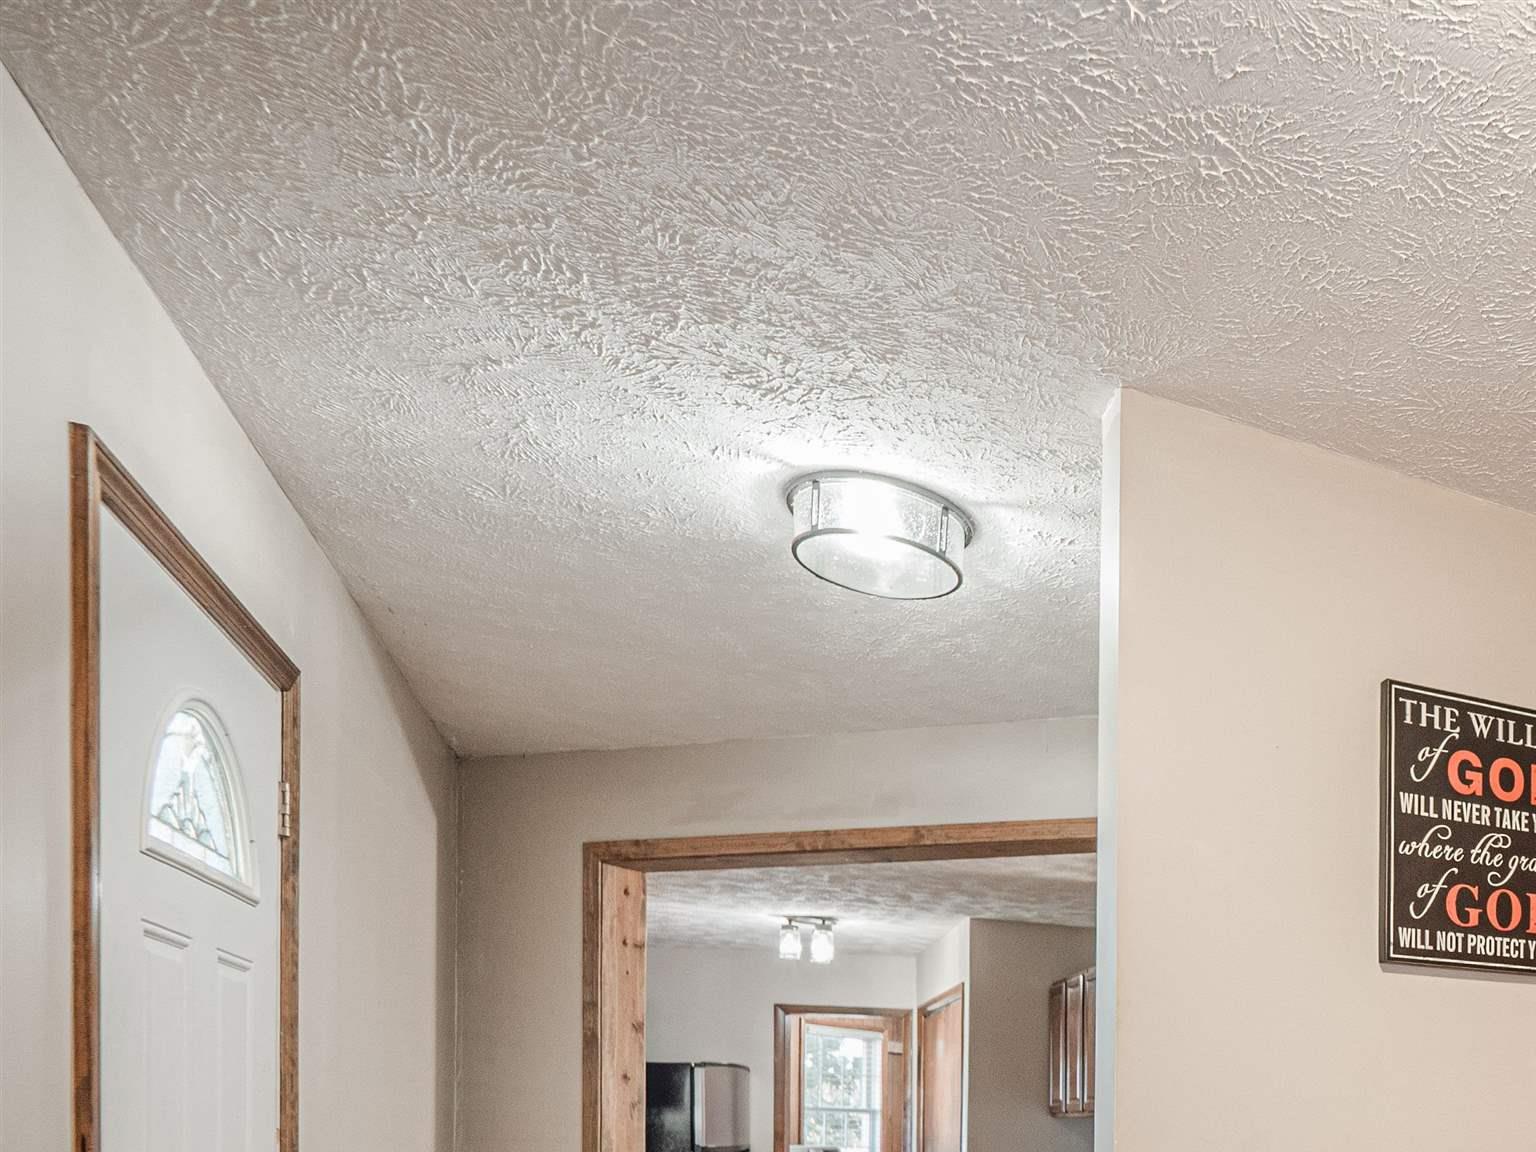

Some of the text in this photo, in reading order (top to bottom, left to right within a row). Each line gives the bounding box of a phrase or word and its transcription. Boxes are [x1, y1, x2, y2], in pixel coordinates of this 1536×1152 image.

[1398, 696, 1461, 734] THE
[1410, 733, 1459, 782] of
[1399, 791, 1439, 819] WILL
[1441, 798, 1491, 827] NEVER
[1494, 807, 1530, 833] TAKE
[1398, 824, 1465, 862] where
[1470, 833, 1512, 868] the
[1409, 867, 1459, 919] of
[1398, 926, 1434, 951] WILL
[1436, 930, 1466, 954] NOT
[1467, 933, 1527, 958] PROTECT
